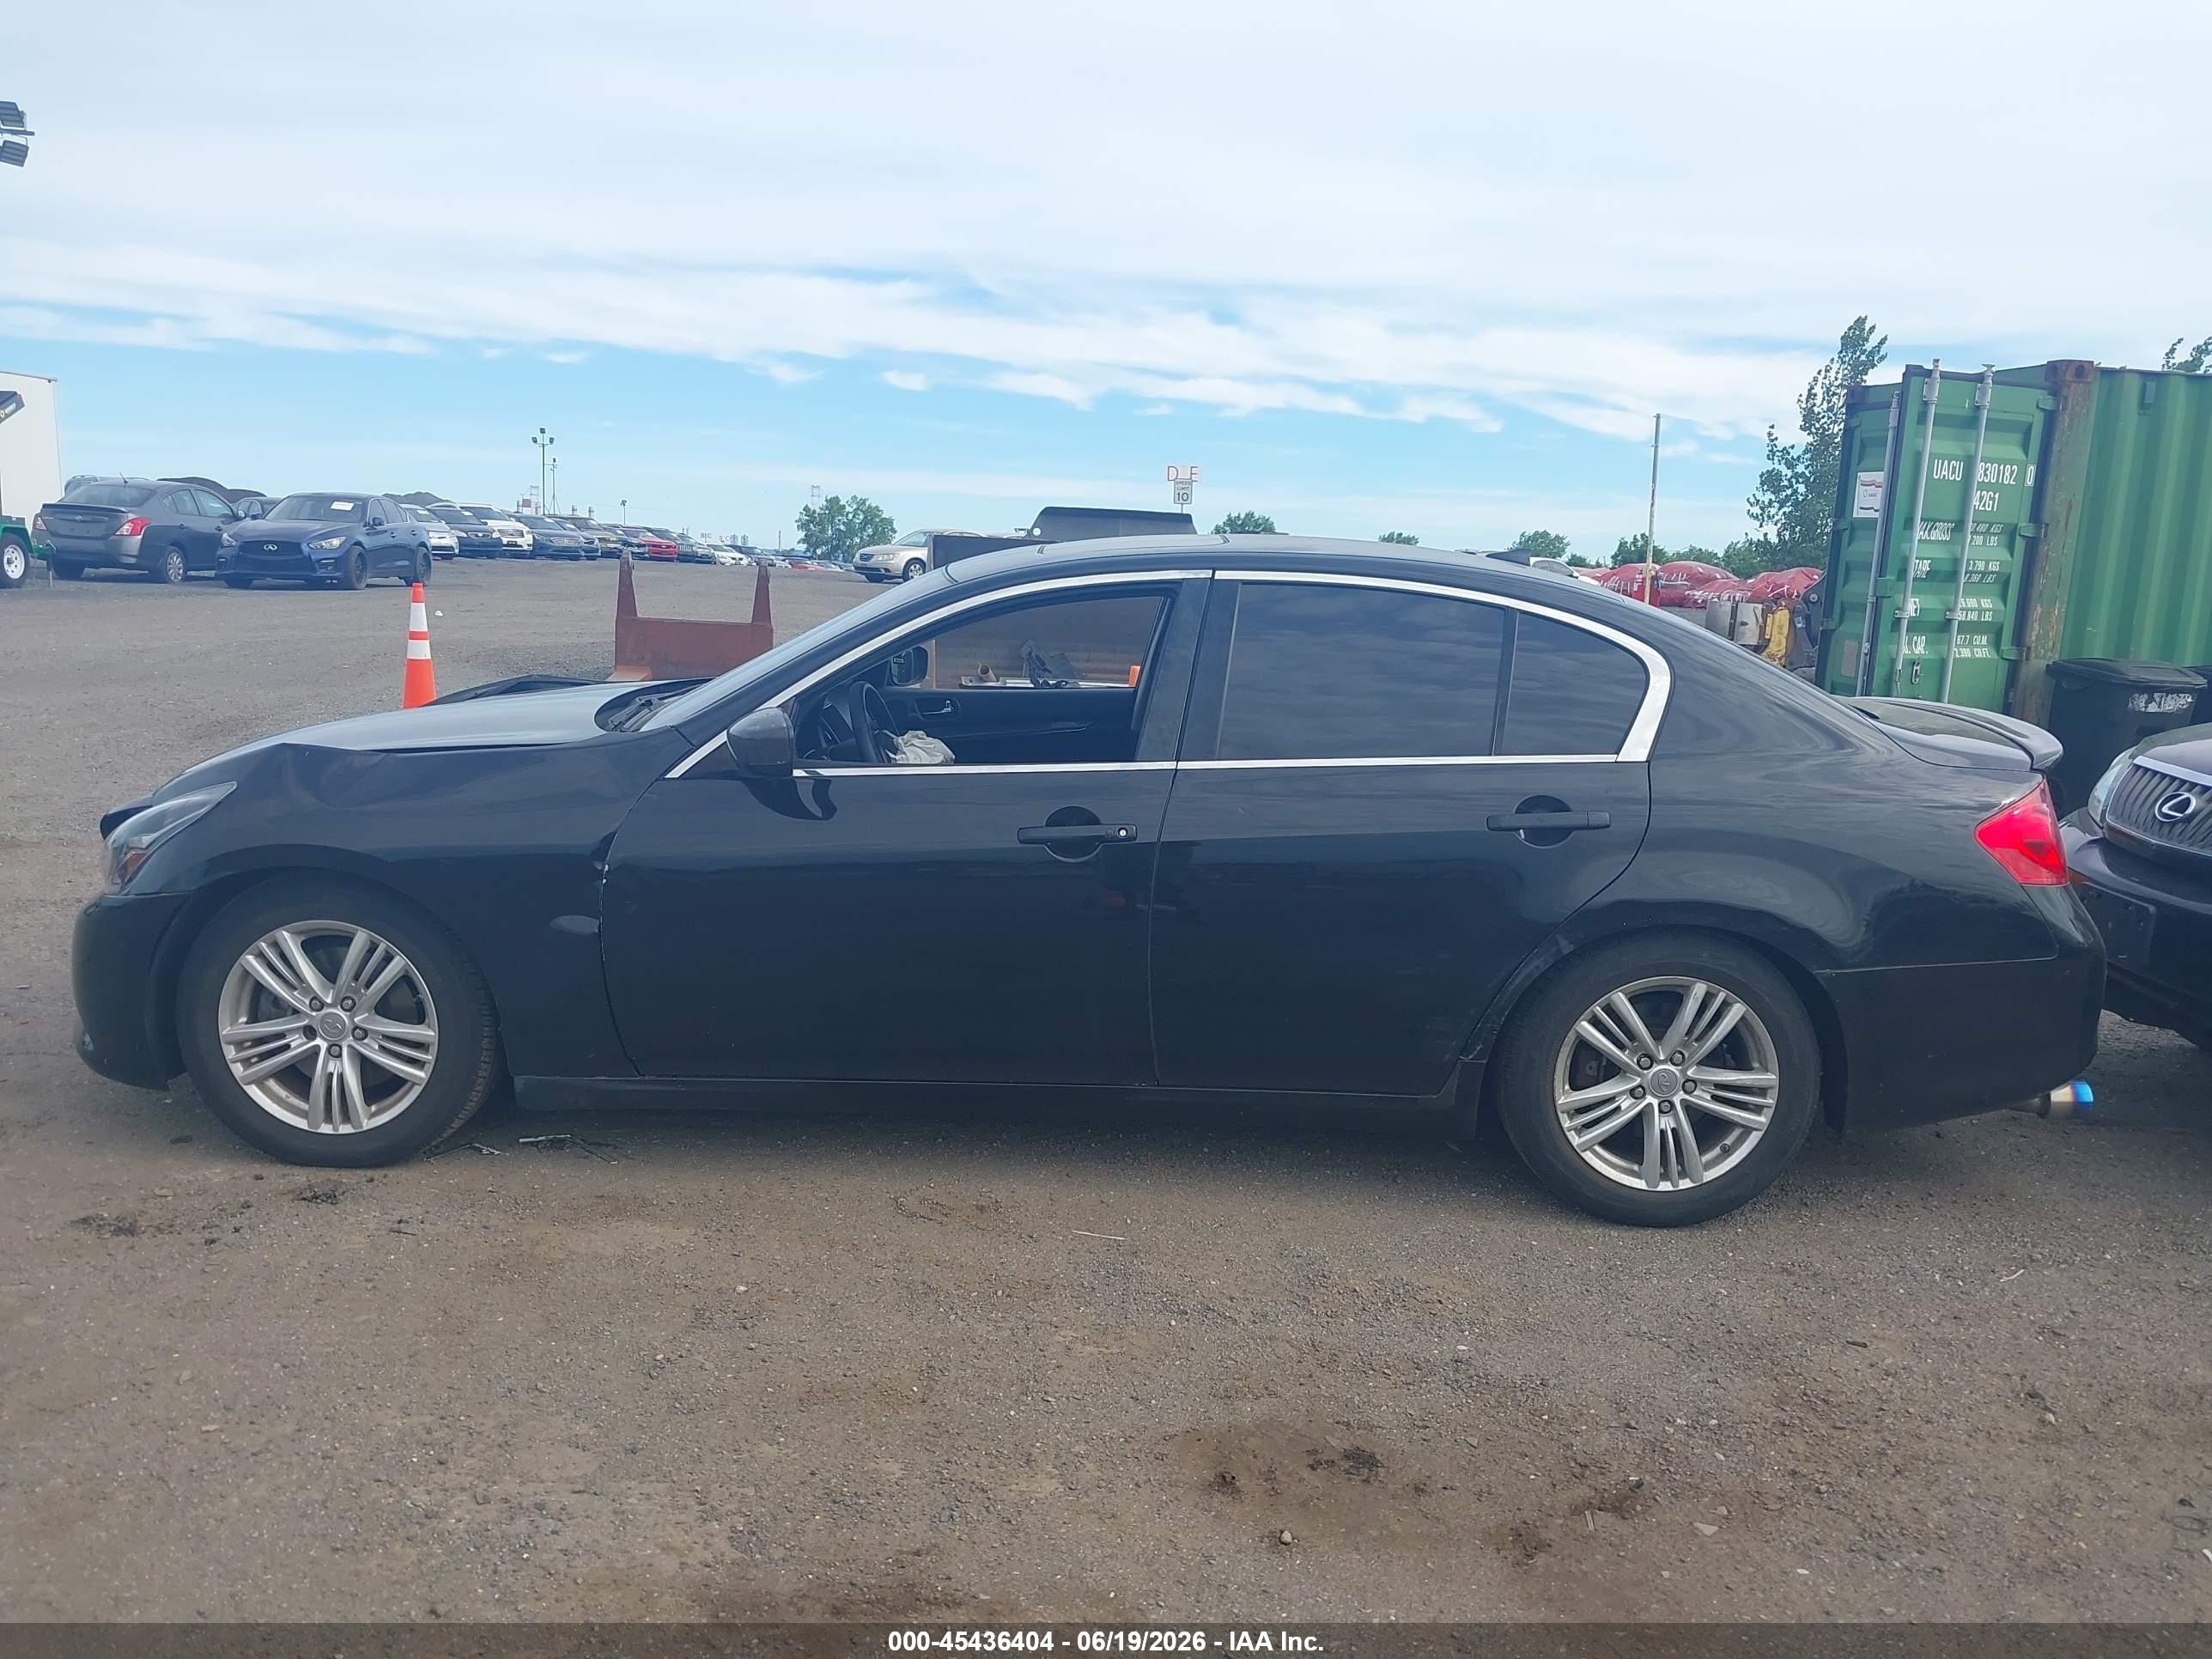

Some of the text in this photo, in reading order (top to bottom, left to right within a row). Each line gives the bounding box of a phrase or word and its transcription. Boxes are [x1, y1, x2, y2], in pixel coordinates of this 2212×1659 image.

[1168, 466, 1199, 482] D E
[1933, 459, 2035, 485] UACU 830182 0
[1177, 492, 1189, 501] 10
[1973, 489, 1999, 512] 42G1
[1970, 522, 2004, 533] 0.480 KGS
[1985, 536, 1998, 546] LBS
[1913, 559, 1932, 579] TARE
[1988, 561, 2001, 572] KGS
[1980, 598, 1993, 609] KGS
[1981, 611, 1993, 622] LBS
[1903, 635, 1911, 654] U.
